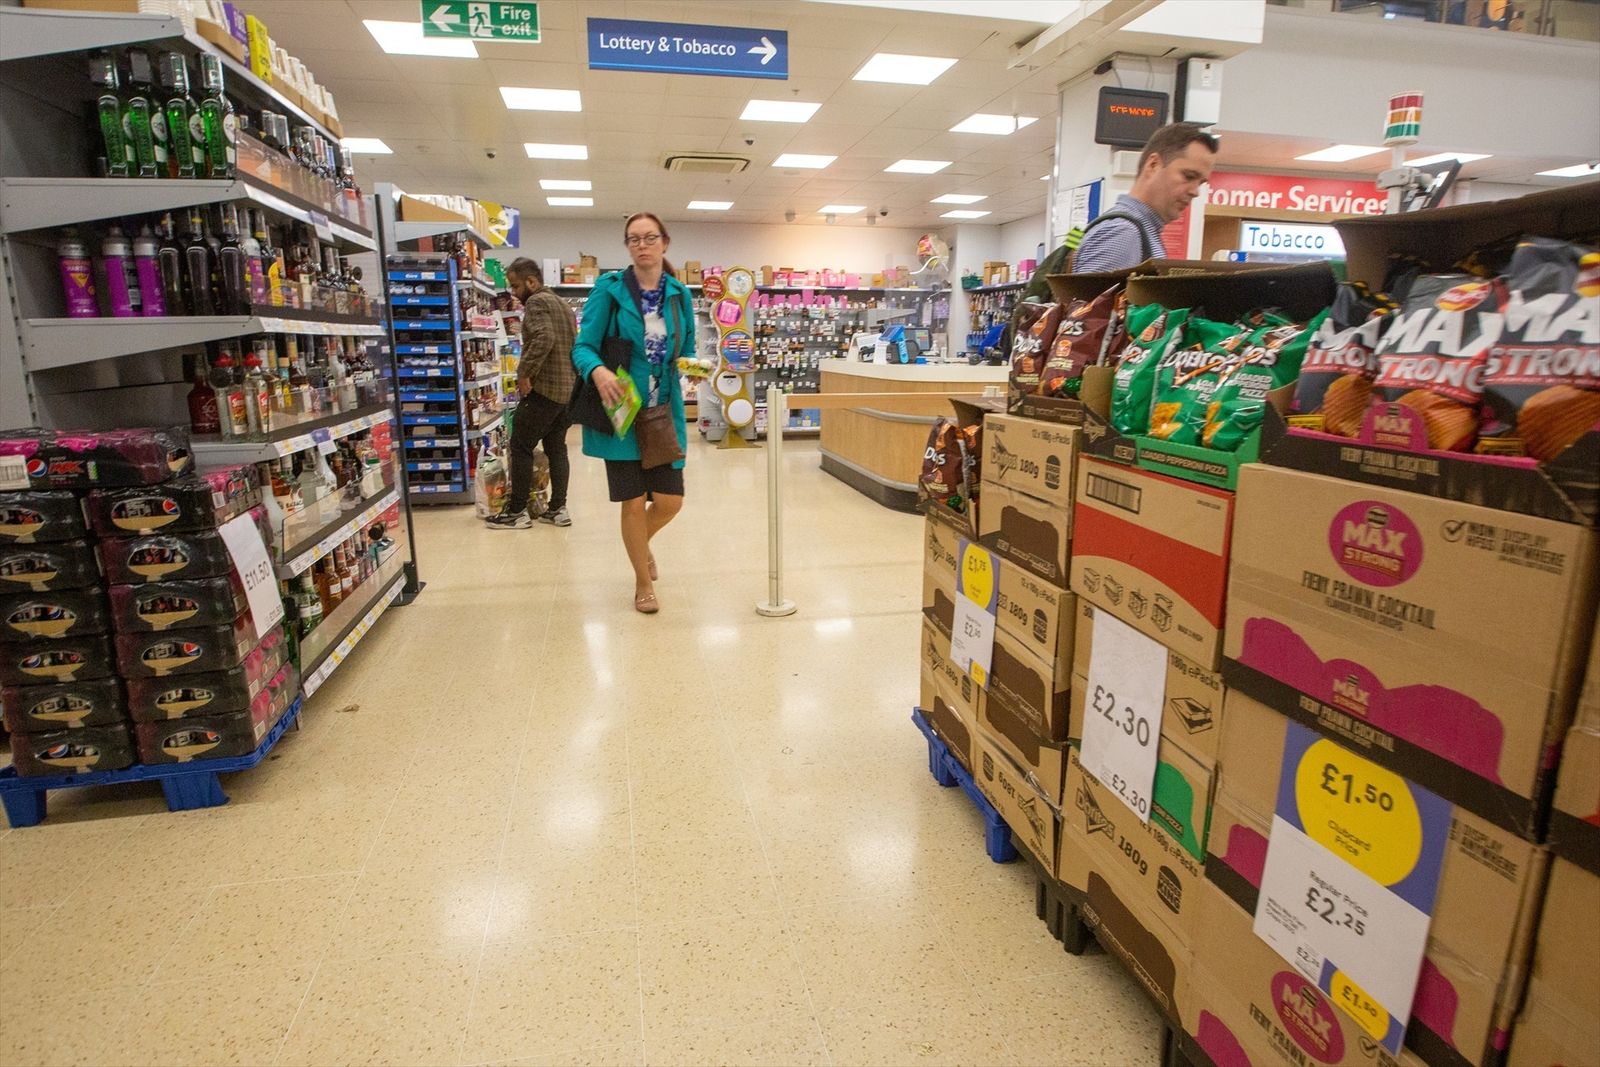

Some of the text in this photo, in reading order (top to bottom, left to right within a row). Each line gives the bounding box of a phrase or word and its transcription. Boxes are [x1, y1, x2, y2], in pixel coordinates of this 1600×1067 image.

[500, 5, 531, 20] Fire
[502, 22, 532, 36] exit
[600, 33, 736, 56] Lottery & Tobacco
[1286, 185, 1389, 215] Services
[1249, 227, 1325, 249] Tobacco
[1507, 290, 1600, 343] MA
[1020, 459, 1039, 478] 180g
[1343, 520, 1408, 556] MAX
[1344, 547, 1401, 571] STRONG
[245, 560, 271, 591] £11.50
[1009, 601, 1028, 626] 180g
[1334, 678, 1369, 704] MAX
[1092, 685, 1150, 747] £2.30
[1112, 774, 1146, 814] £2.30
[1321, 763, 1393, 811] £1.50
[1328, 820, 1371, 851] Clubcard
[1335, 835, 1358, 856] Price
[1118, 835, 1148, 876] 180g
[1310, 870, 1368, 918] Regular Price
[1305, 887, 1366, 936] £2.25
[1282, 984, 1332, 1043] MAX
[1342, 985, 1378, 1018] £1.50
[1282, 1003, 1329, 1051] STRONG
